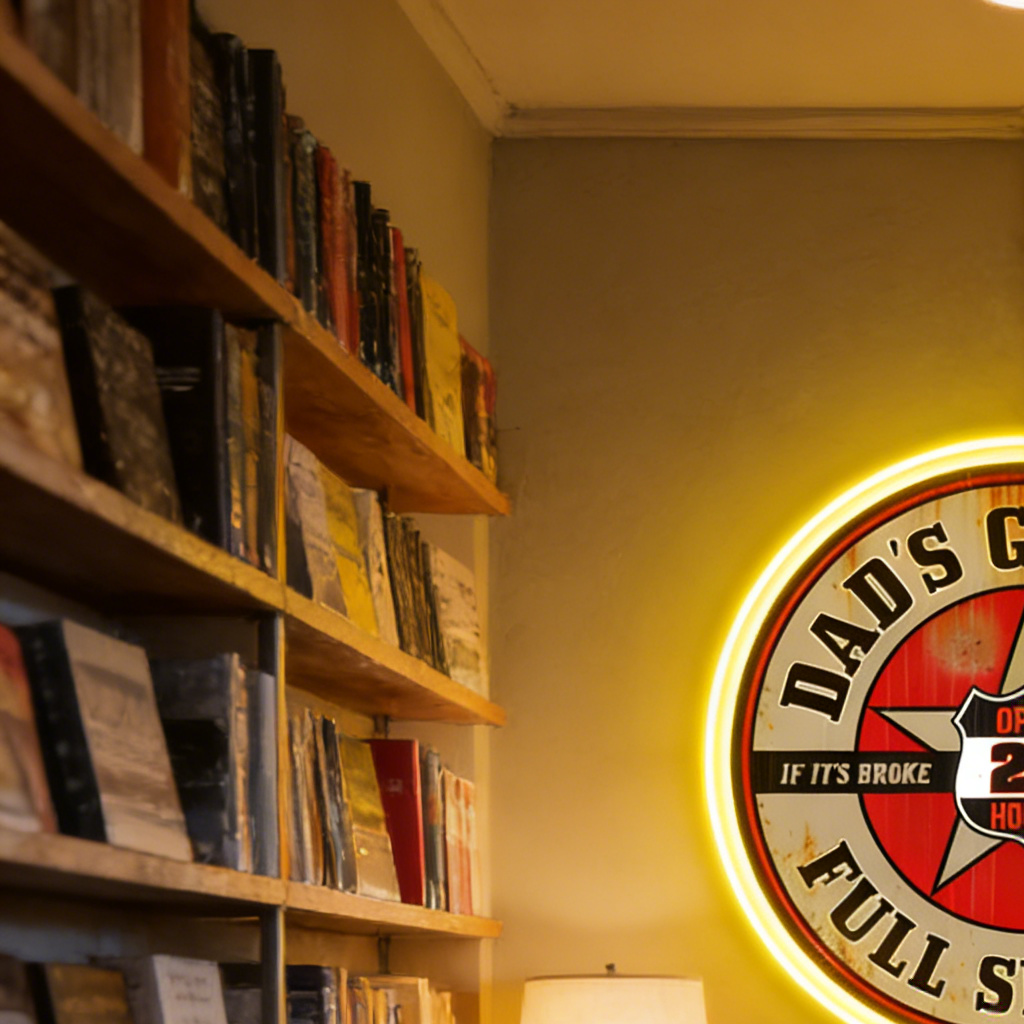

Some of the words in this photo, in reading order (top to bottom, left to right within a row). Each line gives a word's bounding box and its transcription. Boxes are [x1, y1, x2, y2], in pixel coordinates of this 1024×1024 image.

[780, 521, 965, 723] DAD'S
[780, 763, 803, 785] IF
[809, 762, 851, 785] IT'S
[857, 762, 933, 785] BROKE
[796, 840, 951, 999] FULL
